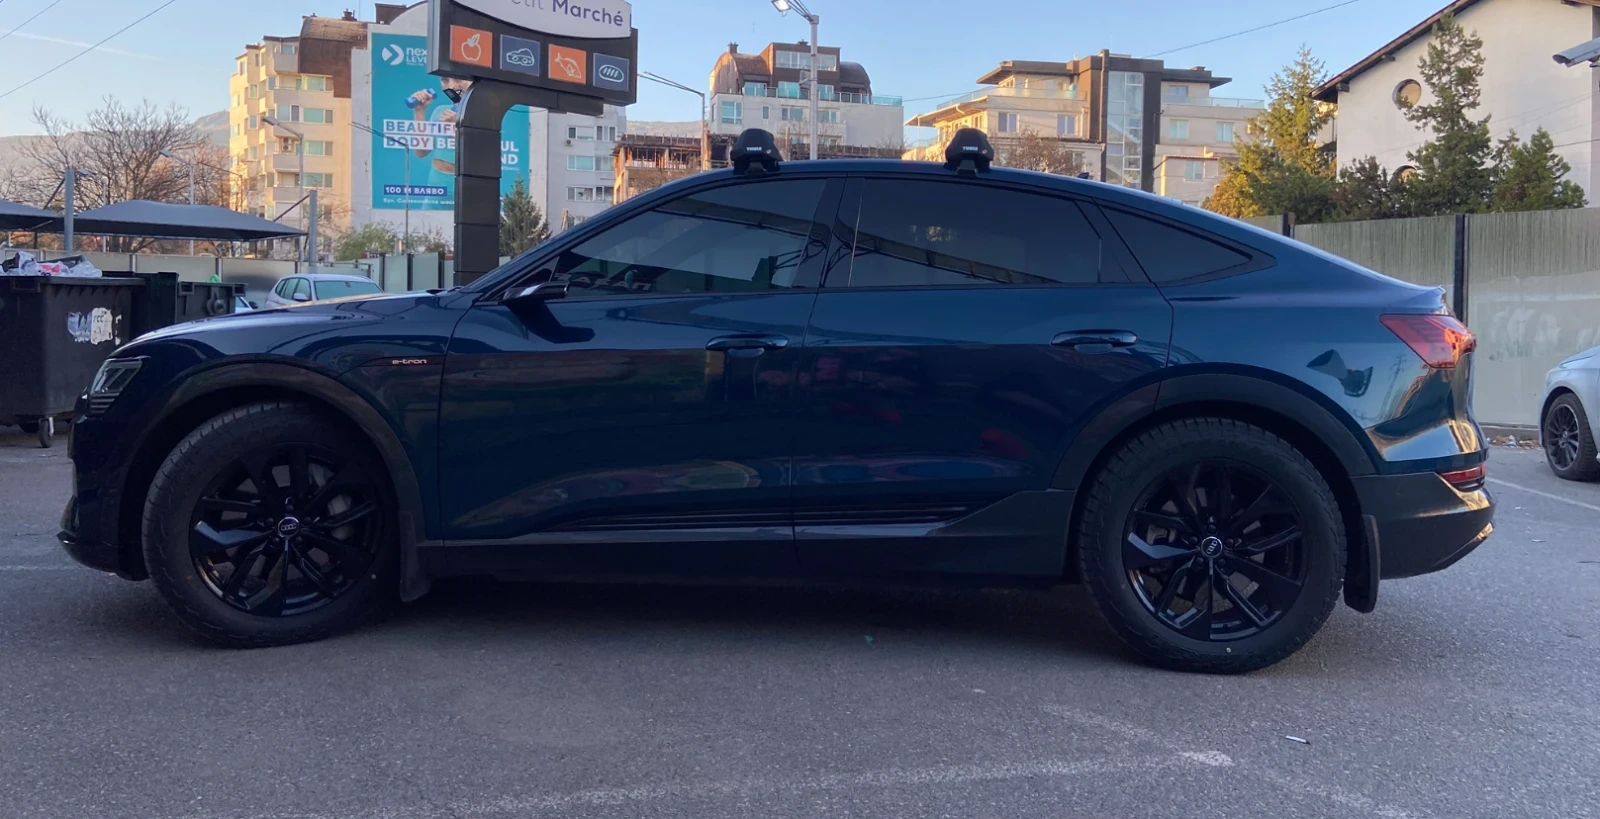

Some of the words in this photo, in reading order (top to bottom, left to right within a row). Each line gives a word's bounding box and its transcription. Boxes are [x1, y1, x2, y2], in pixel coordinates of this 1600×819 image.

[553, 0, 623, 26] Marché
[386, 137, 430, 148] BODY
[414, 187, 444, 195] ВЛЯВО
